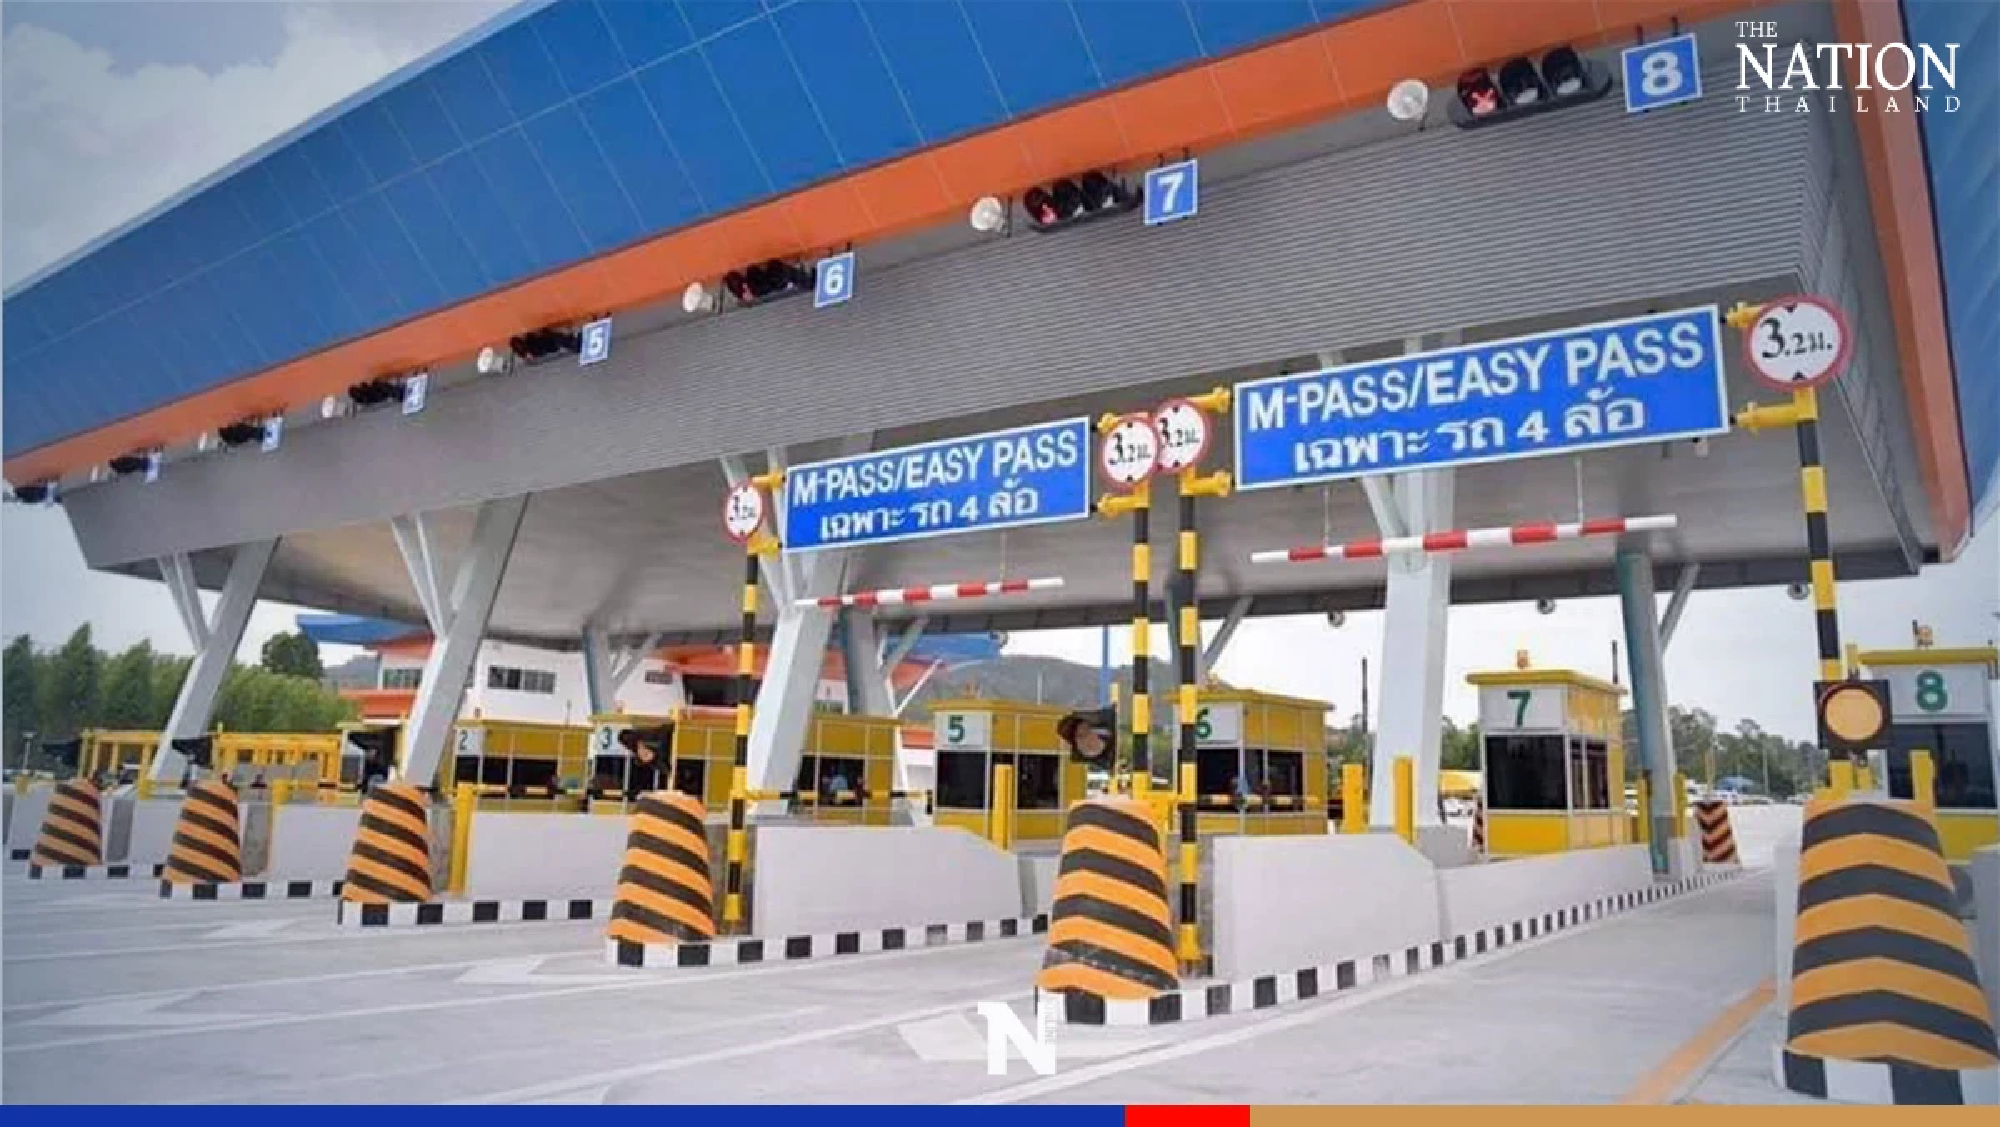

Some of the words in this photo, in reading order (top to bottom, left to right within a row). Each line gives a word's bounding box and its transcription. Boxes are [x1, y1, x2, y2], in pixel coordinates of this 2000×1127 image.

[1641, 51, 1683, 96] 8
[1157, 172, 1183, 213] 7
[824, 262, 844, 296] 6
[1247, 343, 1550, 432] M-PASS/EASY
[1564, 321, 1704, 386] PASS
[1516, 410, 1549, 443] 4
[1563, 384, 1646, 438] ล้อ
[793, 444, 984, 507] M-PASS/EASY
[991, 429, 1078, 478] PASS
[957, 494, 981, 522] 4
[1506, 688, 1533, 727] 7
[1915, 669, 1948, 712] 8
[459, 729, 469, 751] 2
[601, 726, 613, 749] 3
[947, 714, 965, 744] 5
[1195, 707, 1213, 739] 6
